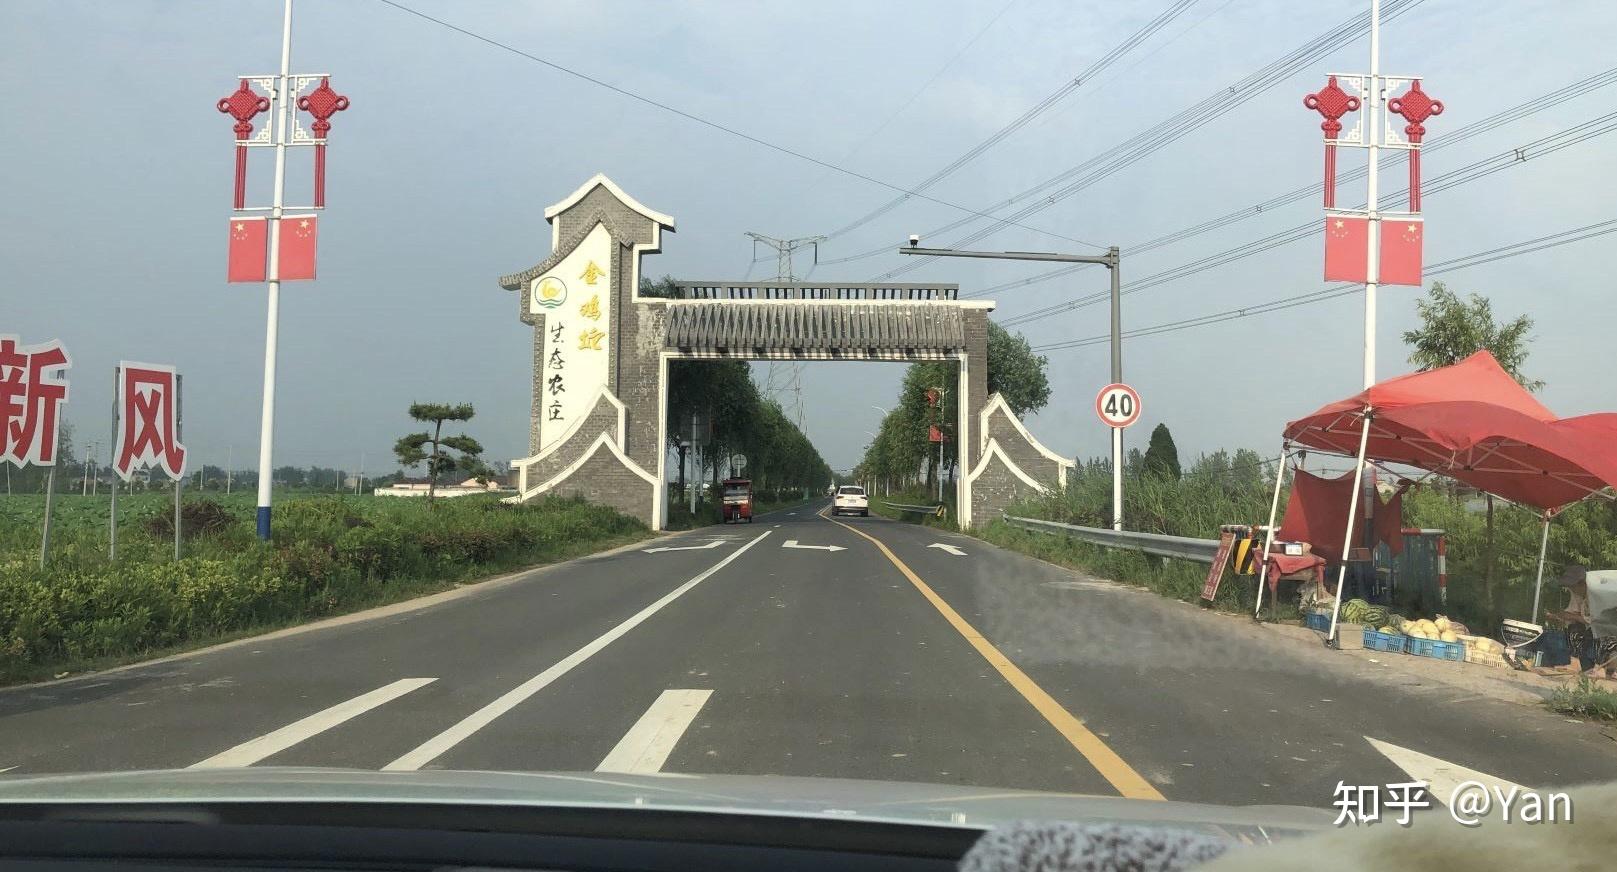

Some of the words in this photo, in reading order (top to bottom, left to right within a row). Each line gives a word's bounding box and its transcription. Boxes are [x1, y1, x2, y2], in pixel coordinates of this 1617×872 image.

[548, 321, 566, 421] 生态农庄
[1105, 393, 1132, 417] 40
